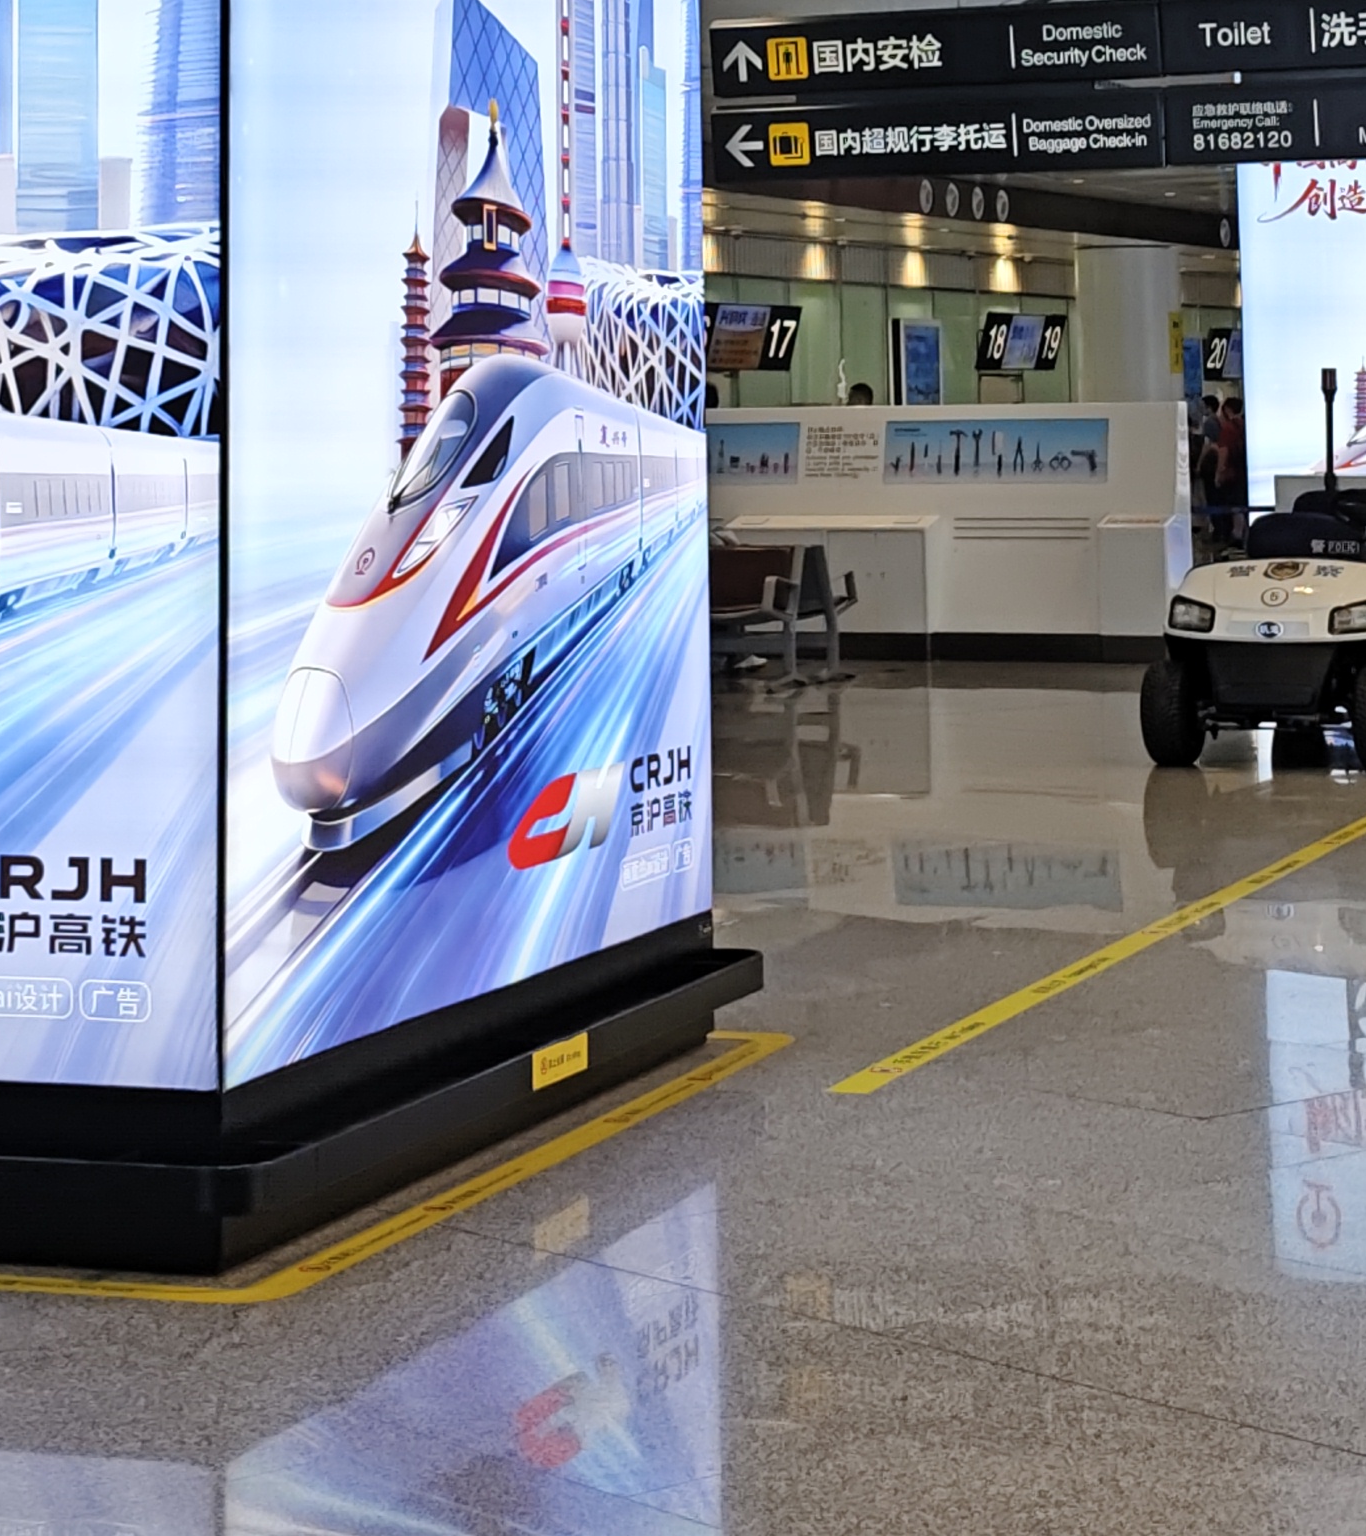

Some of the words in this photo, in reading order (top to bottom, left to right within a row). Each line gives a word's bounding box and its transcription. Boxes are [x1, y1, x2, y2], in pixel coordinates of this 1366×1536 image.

[1042, 21, 1123, 42] Domestic
[1198, 21, 1271, 48] Toilet
[812, 33, 943, 75] 国内安检
[1021, 46, 1089, 67] Security
[1091, 42, 1147, 63] Check
[1022, 116, 1084, 134] Domestic
[1085, 113, 1151, 131] Oversized
[1193, 117, 1253, 130] Emergency
[1255, 115, 1280, 127] Call:
[814, 122, 1007, 156] 国内超规行李托运
[1028, 135, 1086, 154] Baggage
[1088, 132, 1147, 150] Check-in
[1193, 130, 1293, 151] 81682120
[768, 318, 797, 359] 17
[986, 324, 1008, 360] 18
[1041, 325, 1062, 360] 19
[1206, 337, 1227, 369] 20
[630, 745, 691, 794] CRJH
[630, 789, 692, 838] 京沪高铁
[89, 984, 141, 1016] 广告
